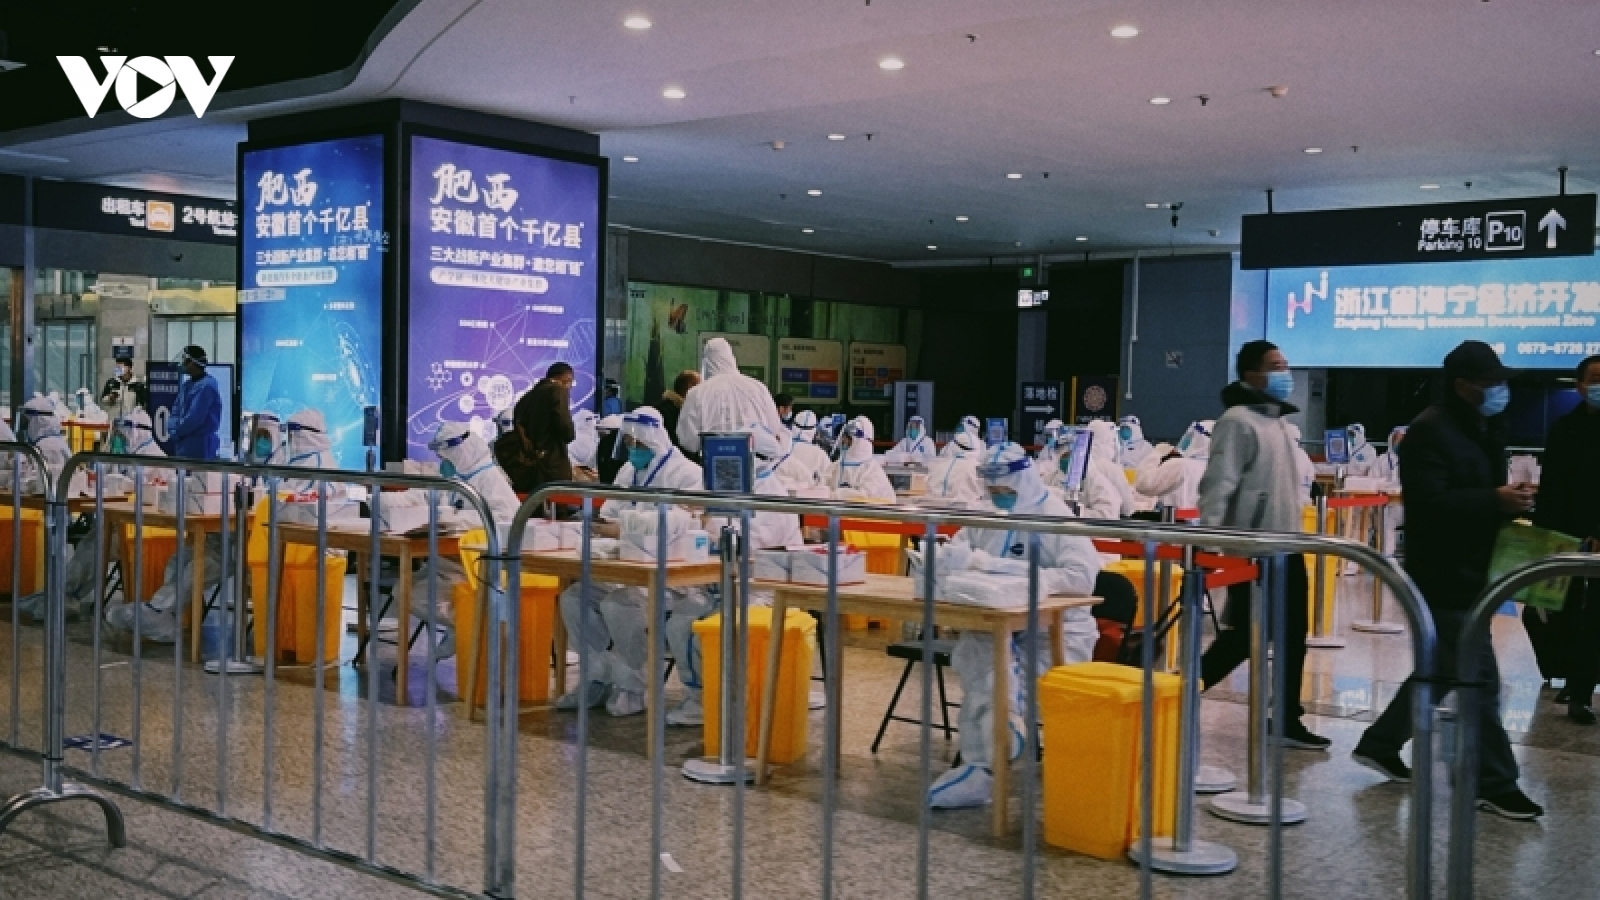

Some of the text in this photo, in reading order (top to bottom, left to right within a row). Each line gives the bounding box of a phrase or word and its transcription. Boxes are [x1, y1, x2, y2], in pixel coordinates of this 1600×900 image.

[1420, 216, 1482, 240] 停车库
[1417, 237, 1483, 252] Parking 10
